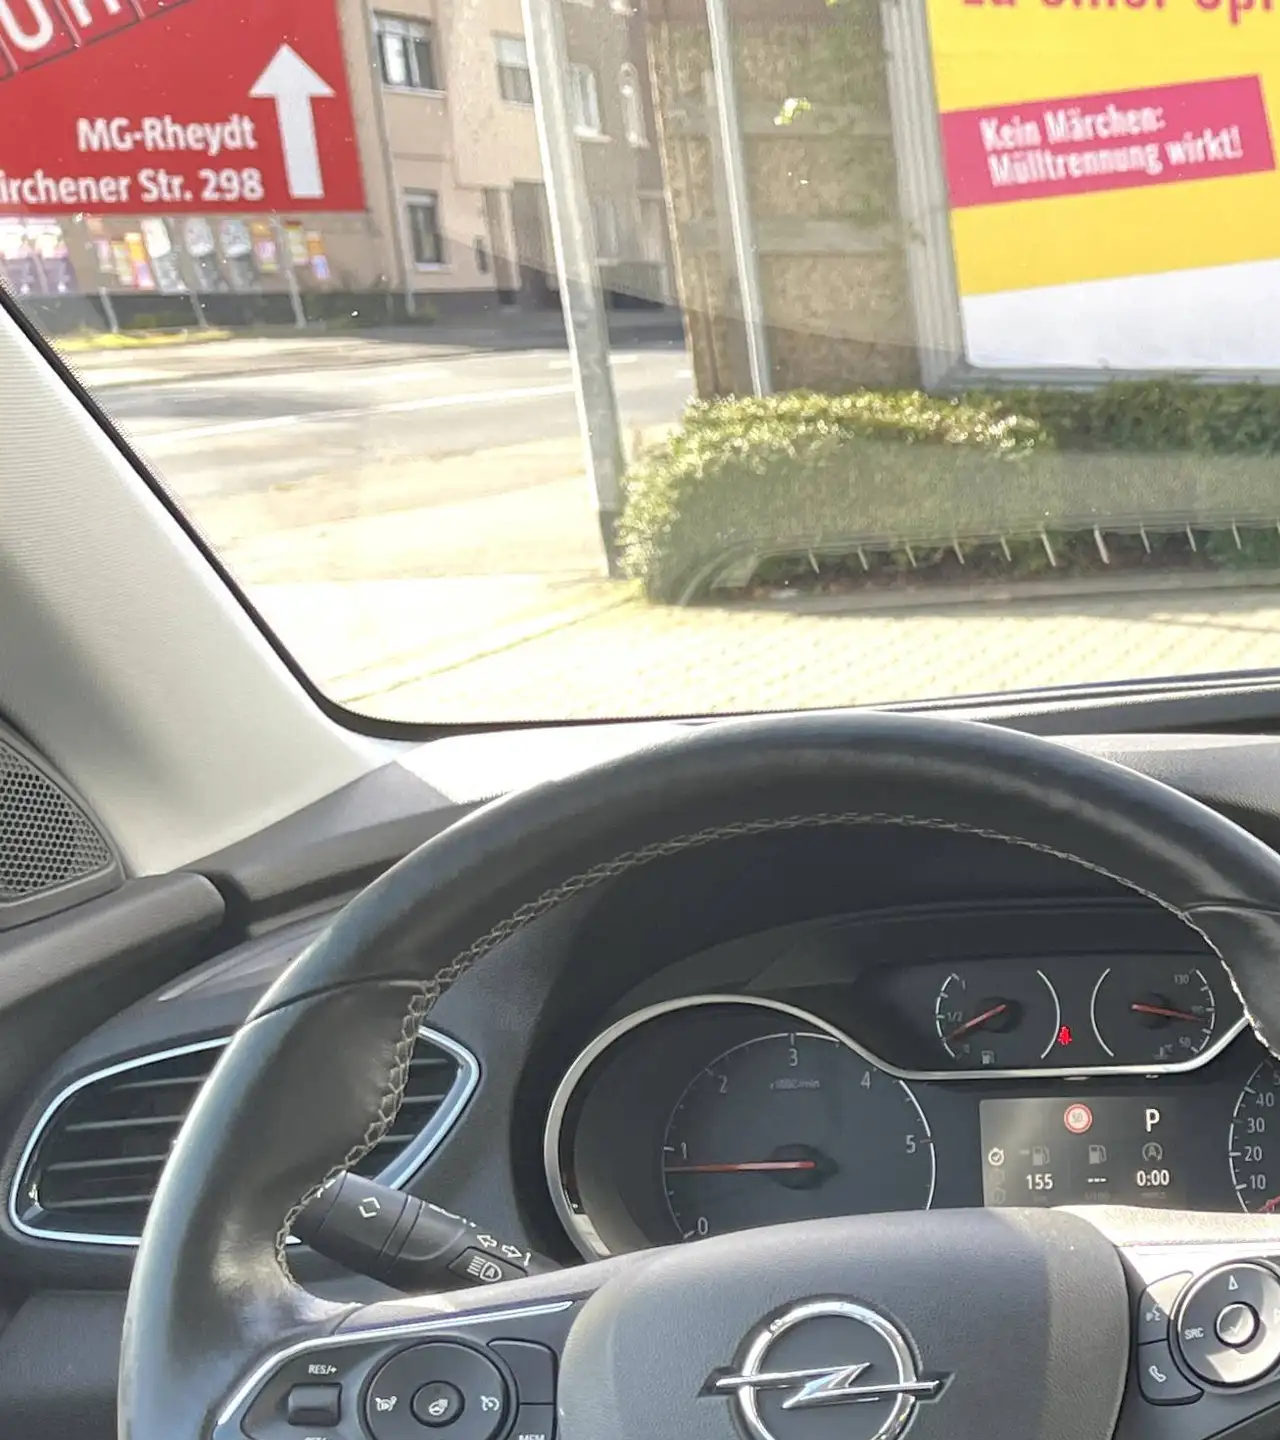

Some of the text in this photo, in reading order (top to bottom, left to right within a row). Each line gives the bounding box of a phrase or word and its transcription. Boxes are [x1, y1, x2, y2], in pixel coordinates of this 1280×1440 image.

[76, 113, 258, 156] MG-Rheydt
[979, 104, 1167, 151] Kein Märchen:
[988, 125, 1244, 187] Mülltrennung wirkt!
[137, 168, 194, 202] Str.
[198, 167, 265, 201] 298
[788, 1049, 798, 1066] 3
[719, 1076, 729, 1094] 2
[860, 1071, 871, 1089] 4
[1255, 1092, 1275, 1107] 40
[1145, 1108, 1160, 1133] P
[1247, 1117, 1265, 1133] 30
[905, 1134, 916, 1153] 5
[1244, 1146, 1263, 1161] 20
[1026, 1173, 1054, 1190] 155
[1136, 1169, 1171, 1187] 0:00
[1250, 1174, 1267, 1190] 10
[697, 1217, 708, 1235] 0
[1184, 1327, 1204, 1340] SRC
[308, 1363, 338, 1376] RES/+
